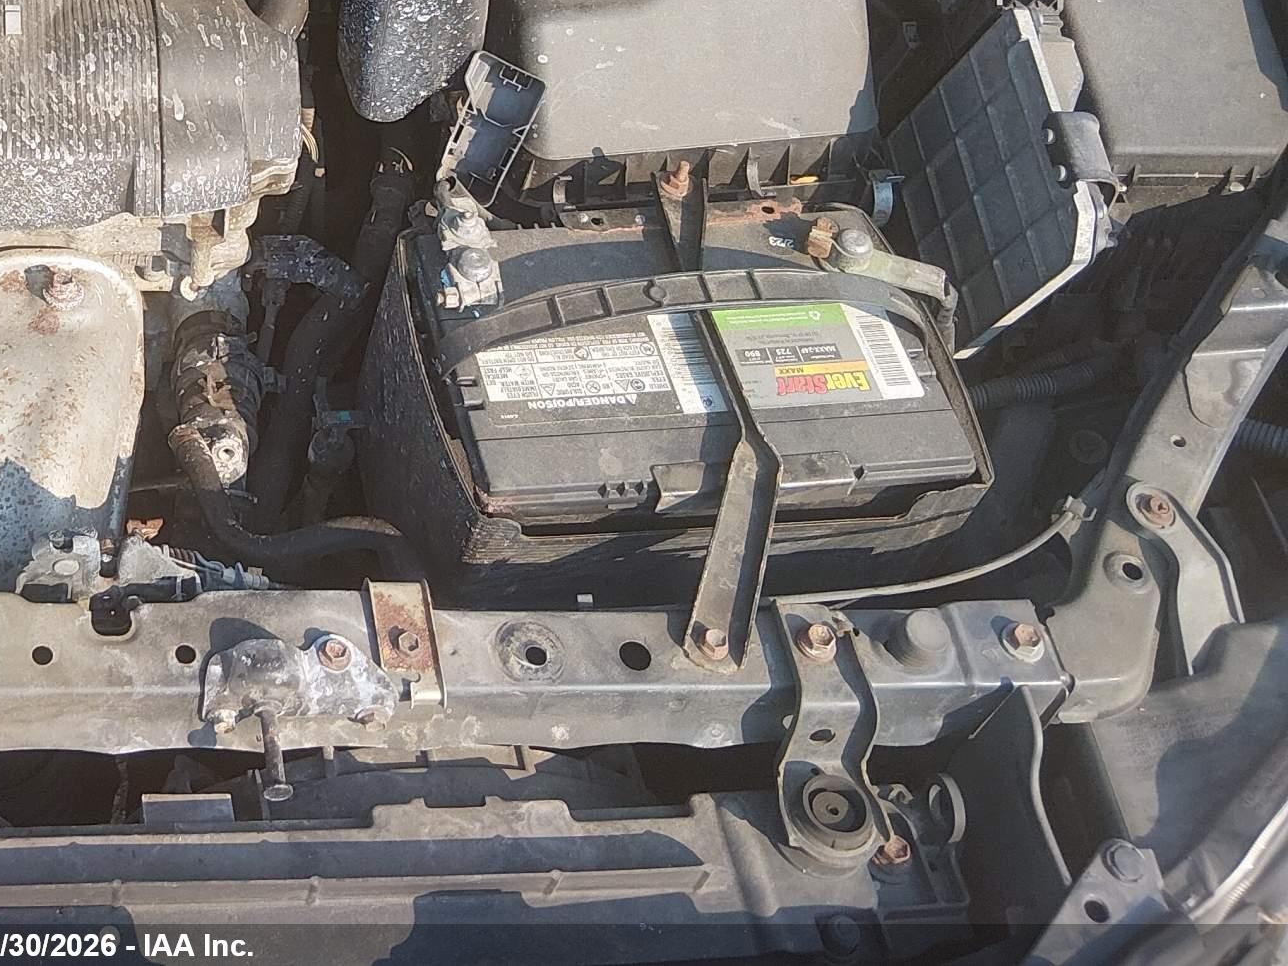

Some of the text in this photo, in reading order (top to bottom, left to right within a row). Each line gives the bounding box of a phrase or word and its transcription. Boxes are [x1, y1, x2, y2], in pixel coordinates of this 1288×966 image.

[744, 349, 762, 359] 890
[778, 367, 804, 376] MAXX
[776, 371, 871, 396] EverStart
[527, 395, 626, 410] DANGER/POISON
